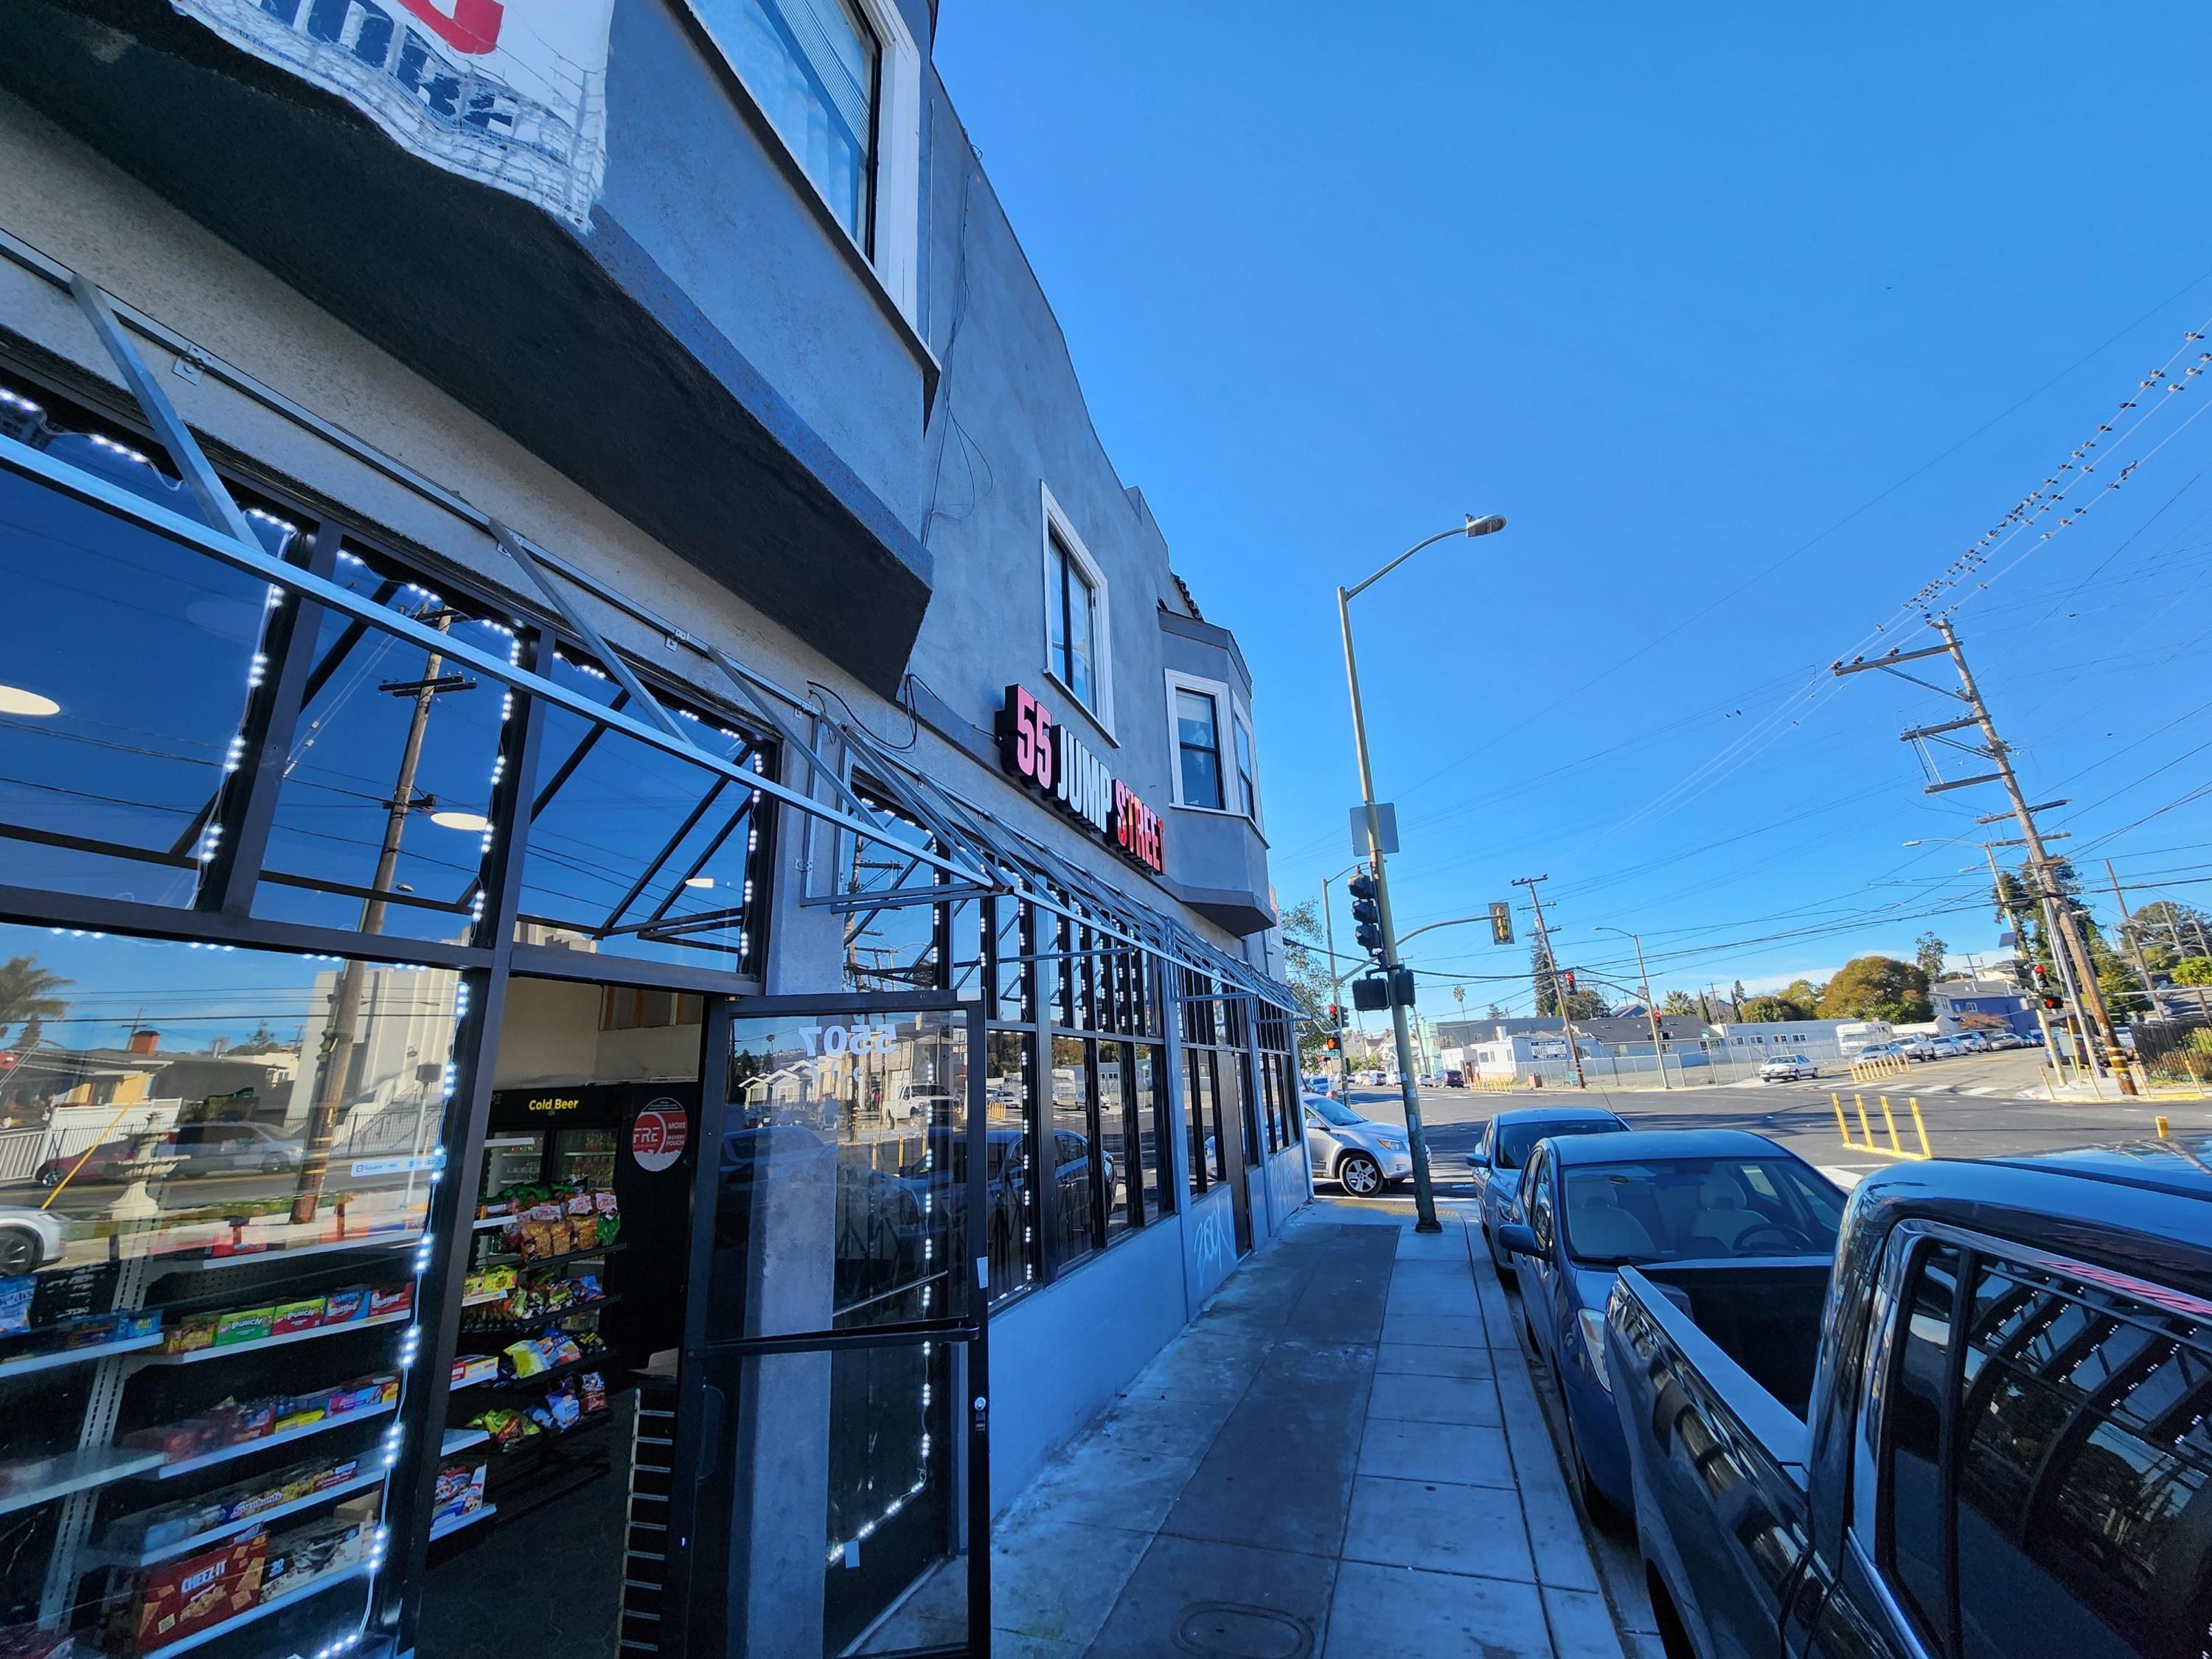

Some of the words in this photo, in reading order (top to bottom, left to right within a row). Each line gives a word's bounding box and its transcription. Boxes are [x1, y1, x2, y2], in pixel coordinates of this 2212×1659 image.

[1017, 684, 1052, 789] 55
[1057, 725, 1111, 833] JUMP
[1116, 779, 1165, 875] STREET
[529, 1099, 552, 1110] Cold
[554, 1099, 579, 1110] Beer
[633, 1127, 661, 1144] FRE
[287, 1310, 316, 1320] PUNCH
[231, 1318, 263, 1329] PUNCH
